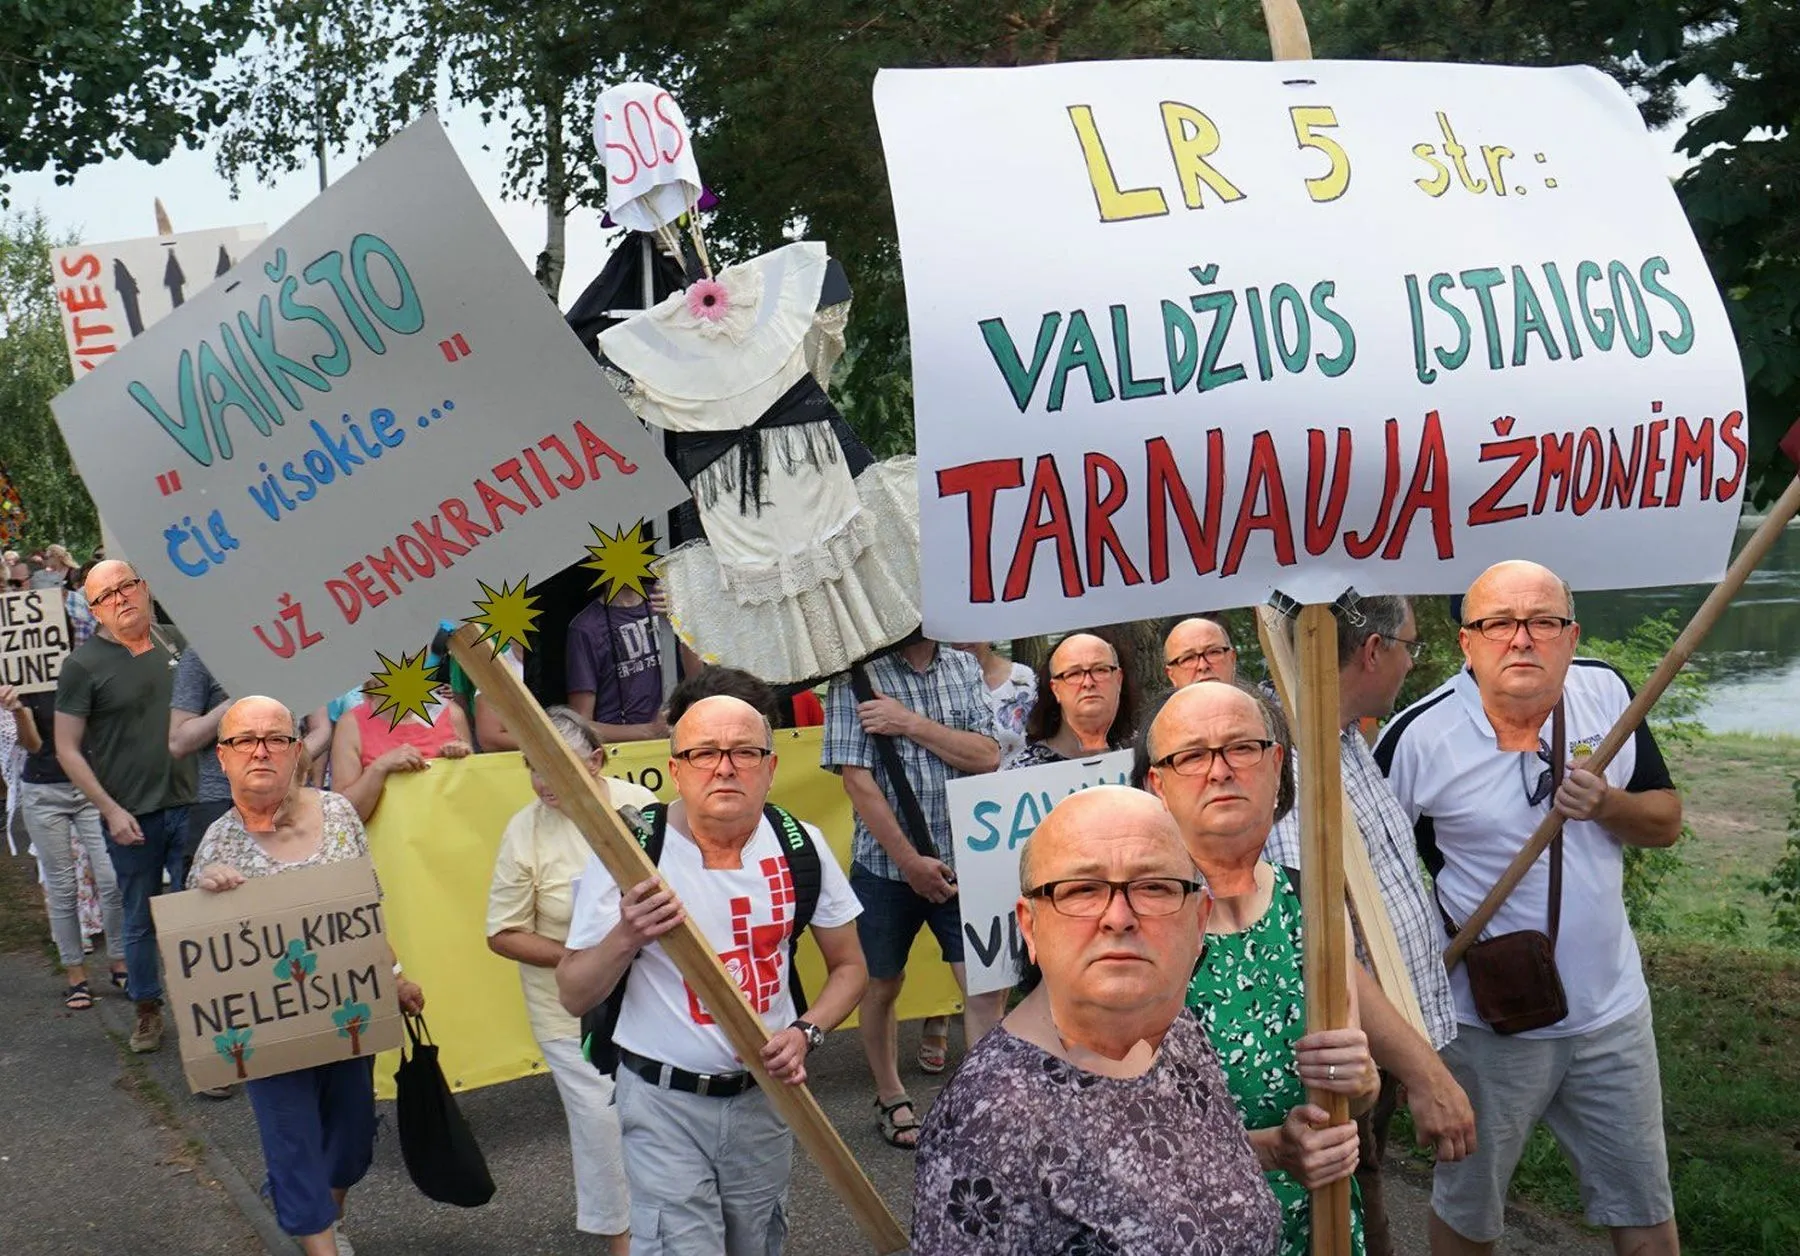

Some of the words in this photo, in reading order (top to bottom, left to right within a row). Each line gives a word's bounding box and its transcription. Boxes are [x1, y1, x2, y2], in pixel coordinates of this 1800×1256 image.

[1067, 101, 1247, 223] LR
[1288, 106, 1351, 203] 5
[127, 233, 425, 467] VAIKŠTO
[977, 263, 1356, 413] VALDŽIOS
[1405, 256, 1695, 384] ĮSTAIGOS
[248, 399, 455, 522] visokie...
[936, 410, 1454, 604] TARNAUJA
[1467, 401, 1747, 526] ŽMONĖMS
[252, 592, 325, 659] UŽ
[325, 420, 639, 626] DEMOKRATIJĄ
[302, 902, 382, 951] KIRST
[191, 964, 381, 1037] NELEISIM
